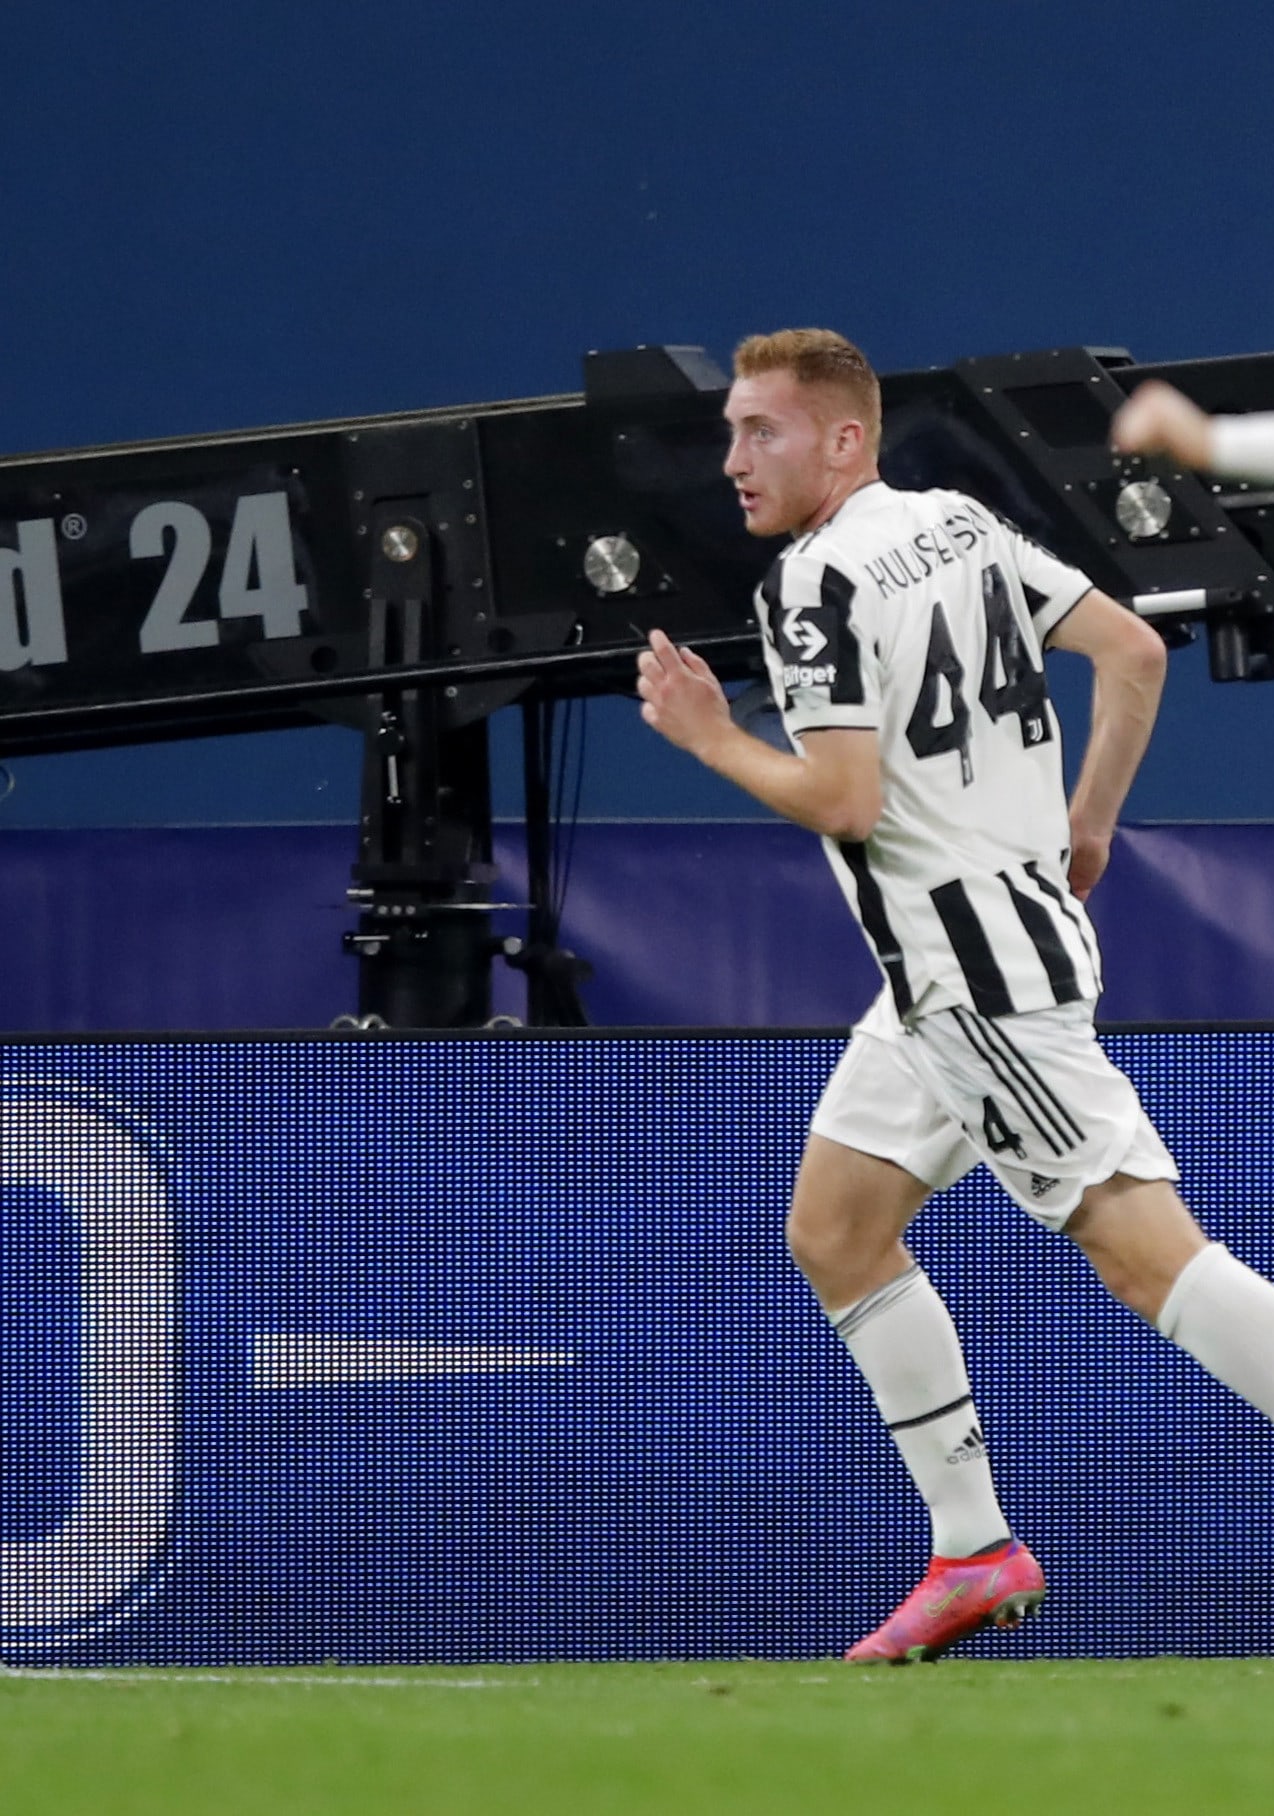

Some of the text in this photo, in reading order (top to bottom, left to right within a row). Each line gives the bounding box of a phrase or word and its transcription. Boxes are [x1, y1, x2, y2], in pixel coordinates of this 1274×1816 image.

[129, 491, 309, 654] 24
[905, 562, 1053, 788] 44
[982, 1095, 1027, 1160] 4
